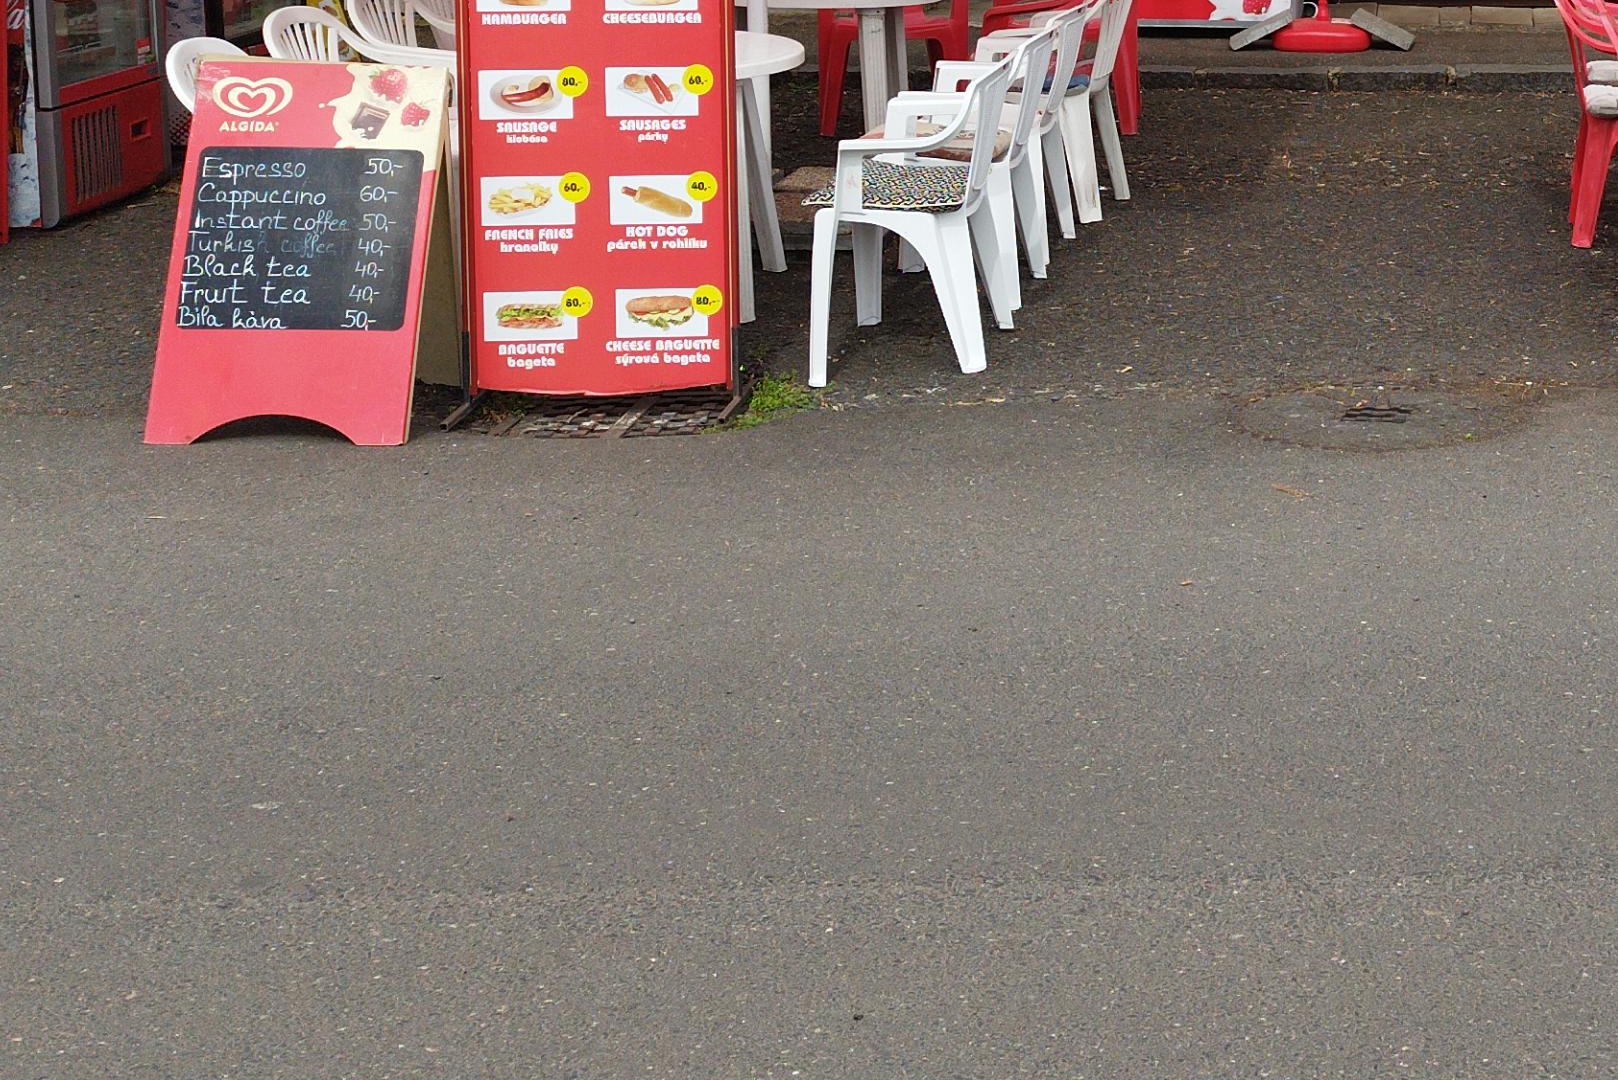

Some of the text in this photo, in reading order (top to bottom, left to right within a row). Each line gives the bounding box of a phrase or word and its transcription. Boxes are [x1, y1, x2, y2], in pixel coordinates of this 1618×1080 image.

[482, 13, 566, 25] HAMBURGER
[603, 13, 701, 24] CHEESEBURGER
[219, 121, 274, 132] ALGIDA
[497, 122, 557, 133] SAUSAGE
[620, 120, 686, 131] SAUSAGES
[202, 156, 306, 185] Espresso
[197, 182, 398, 210] Cappuccino 60,-
[194, 209, 288, 230] Instant
[293, 209, 351, 236] coffee
[485, 228, 573, 241] FRENCH FRIES
[626, 226, 688, 237] HOT DOG
[500, 241, 558, 254] hranolky
[607, 239, 646, 252] párek
[649, 240, 658, 249] v
[182, 255, 257, 277] Black
[265, 255, 312, 277] tea
[261, 280, 311, 304] tea
[498, 343, 565, 355] BAGUETTE
[606, 339, 720, 351] CHEESE BAGUETTE
[507, 356, 555, 369] bageta
[663, 353, 711, 364] bageta
